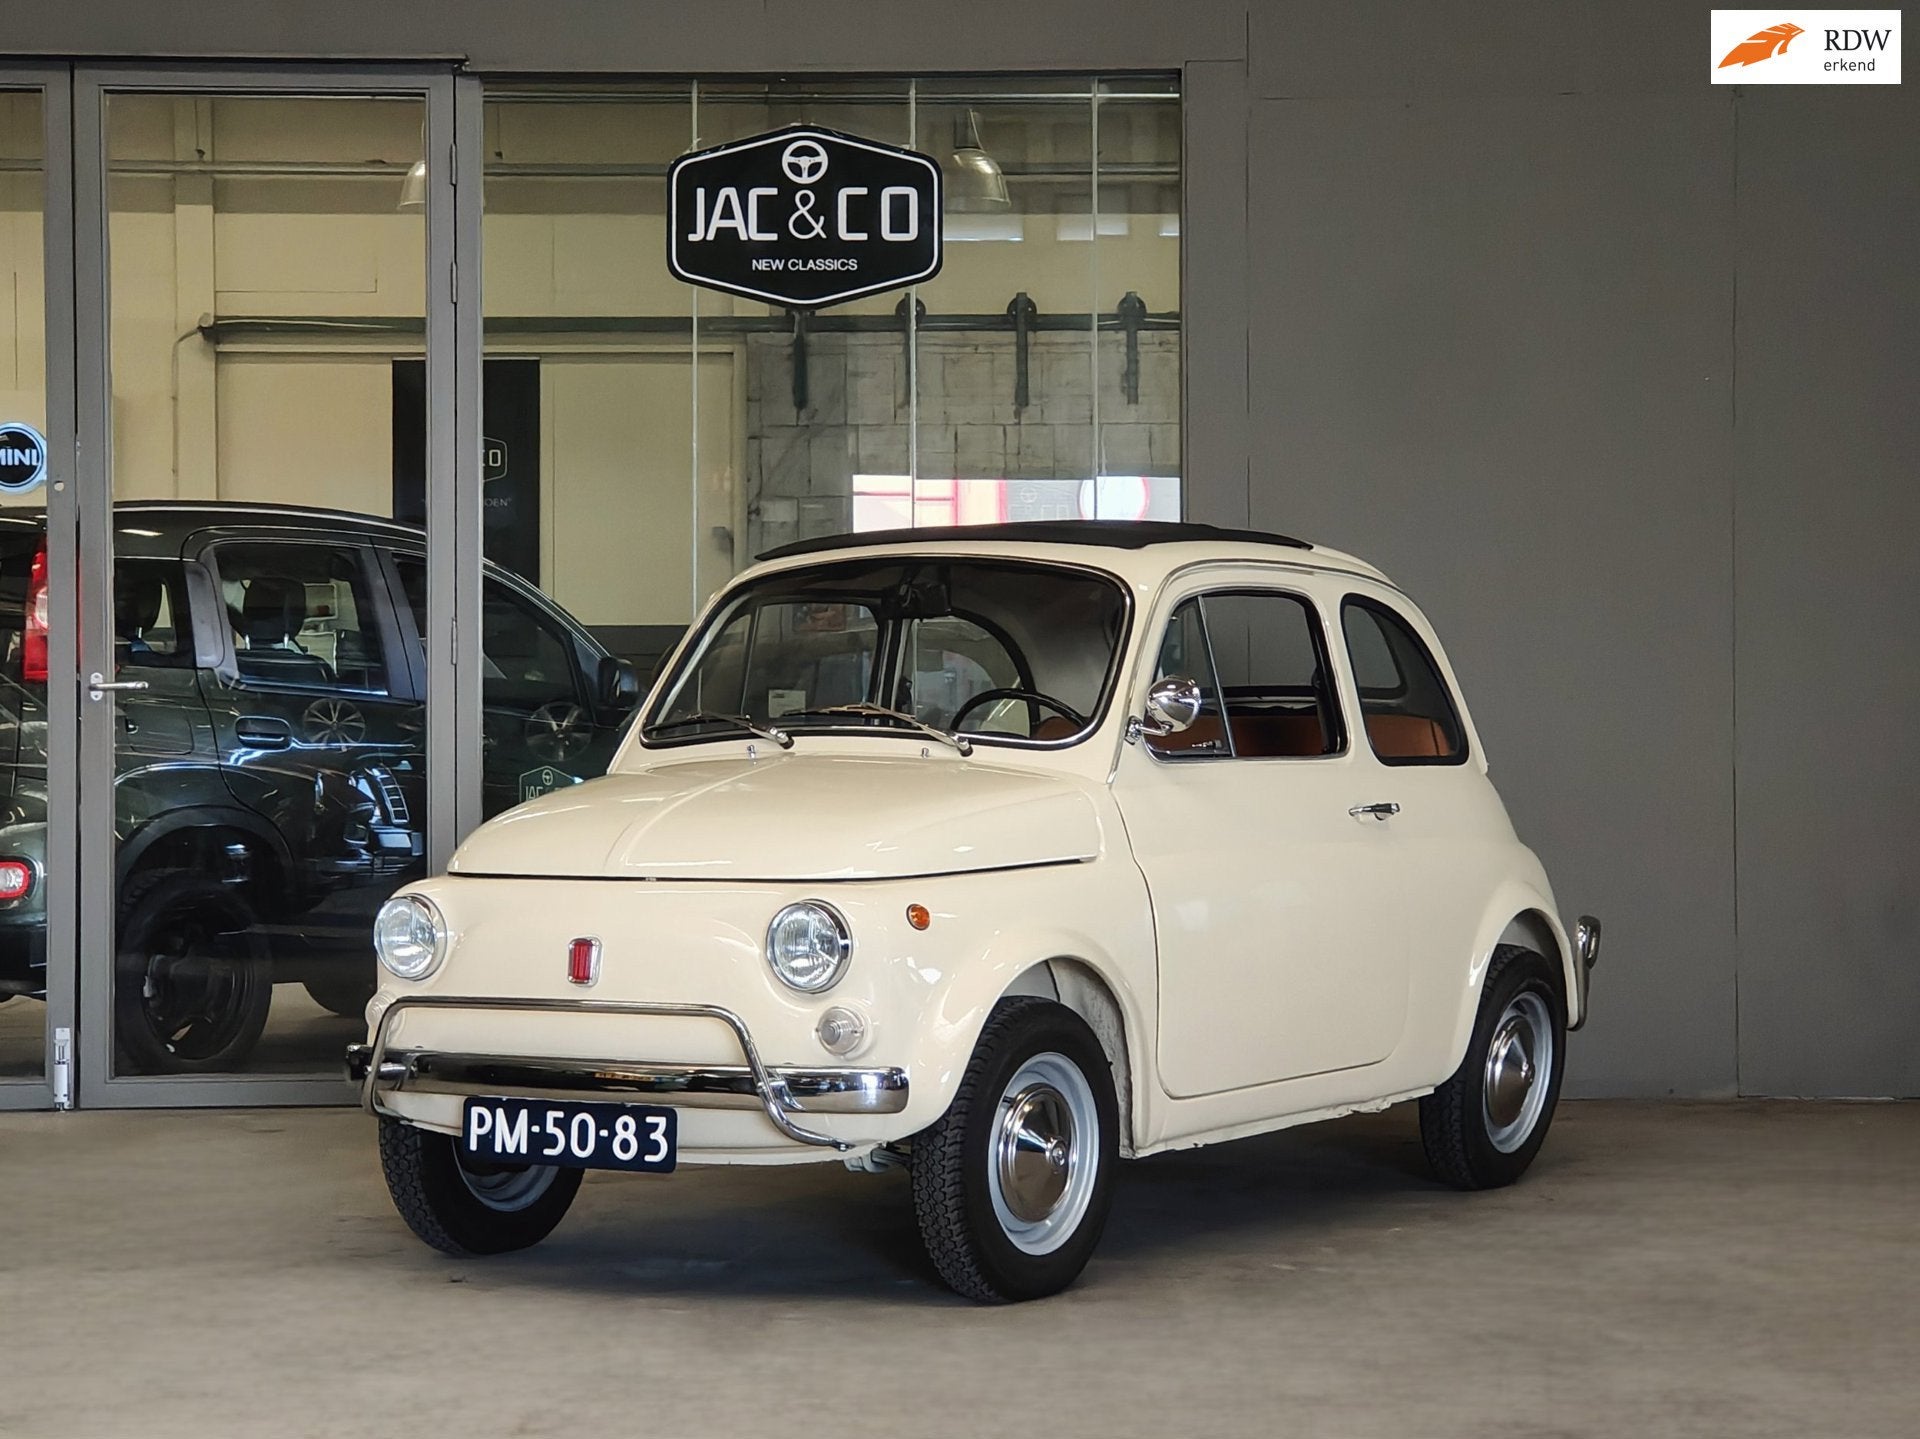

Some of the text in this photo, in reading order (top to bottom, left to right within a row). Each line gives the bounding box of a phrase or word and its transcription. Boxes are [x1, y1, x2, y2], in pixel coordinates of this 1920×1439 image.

[688, 187, 778, 241] JAC
[788, 189, 827, 240] &
[751, 259, 858, 271] NEW CLASSICS
[469, 1106, 669, 1163] PM-50-83
